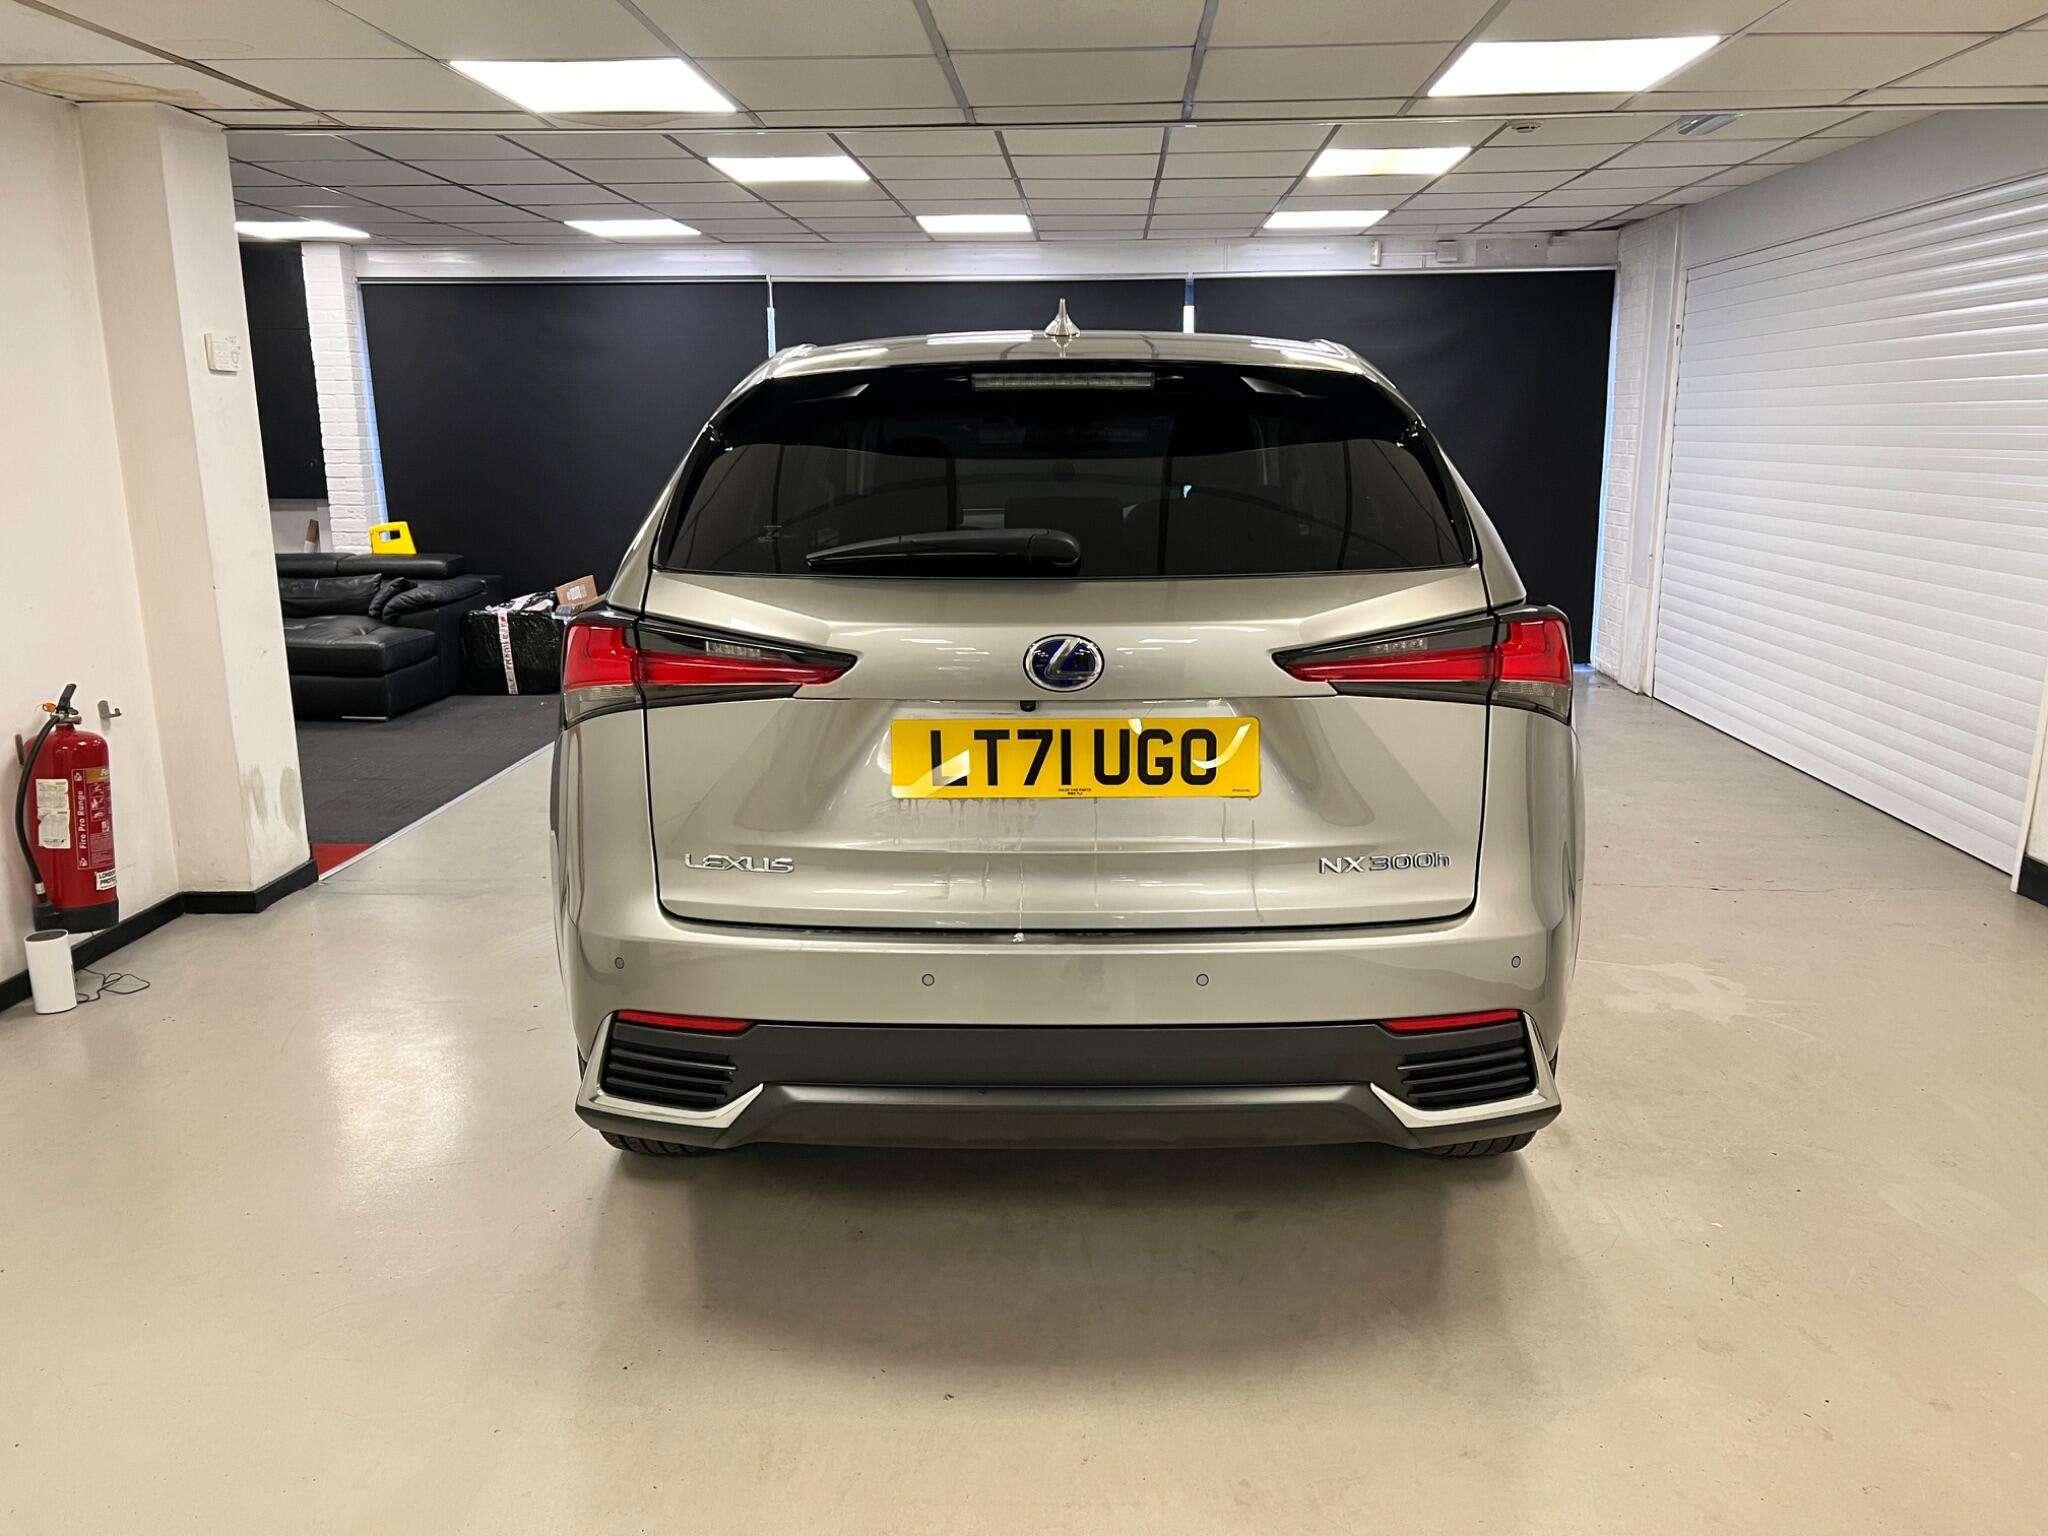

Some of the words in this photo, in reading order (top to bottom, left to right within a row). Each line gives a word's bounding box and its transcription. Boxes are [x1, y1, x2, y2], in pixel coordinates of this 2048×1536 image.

[930, 729, 1072, 787] LT71
[1093, 728, 1218, 786] UGO
[77, 790, 85, 816] Range
[78, 818, 86, 832] Pro
[79, 834, 87, 849] Fire
[684, 853, 795, 873] LEXUS
